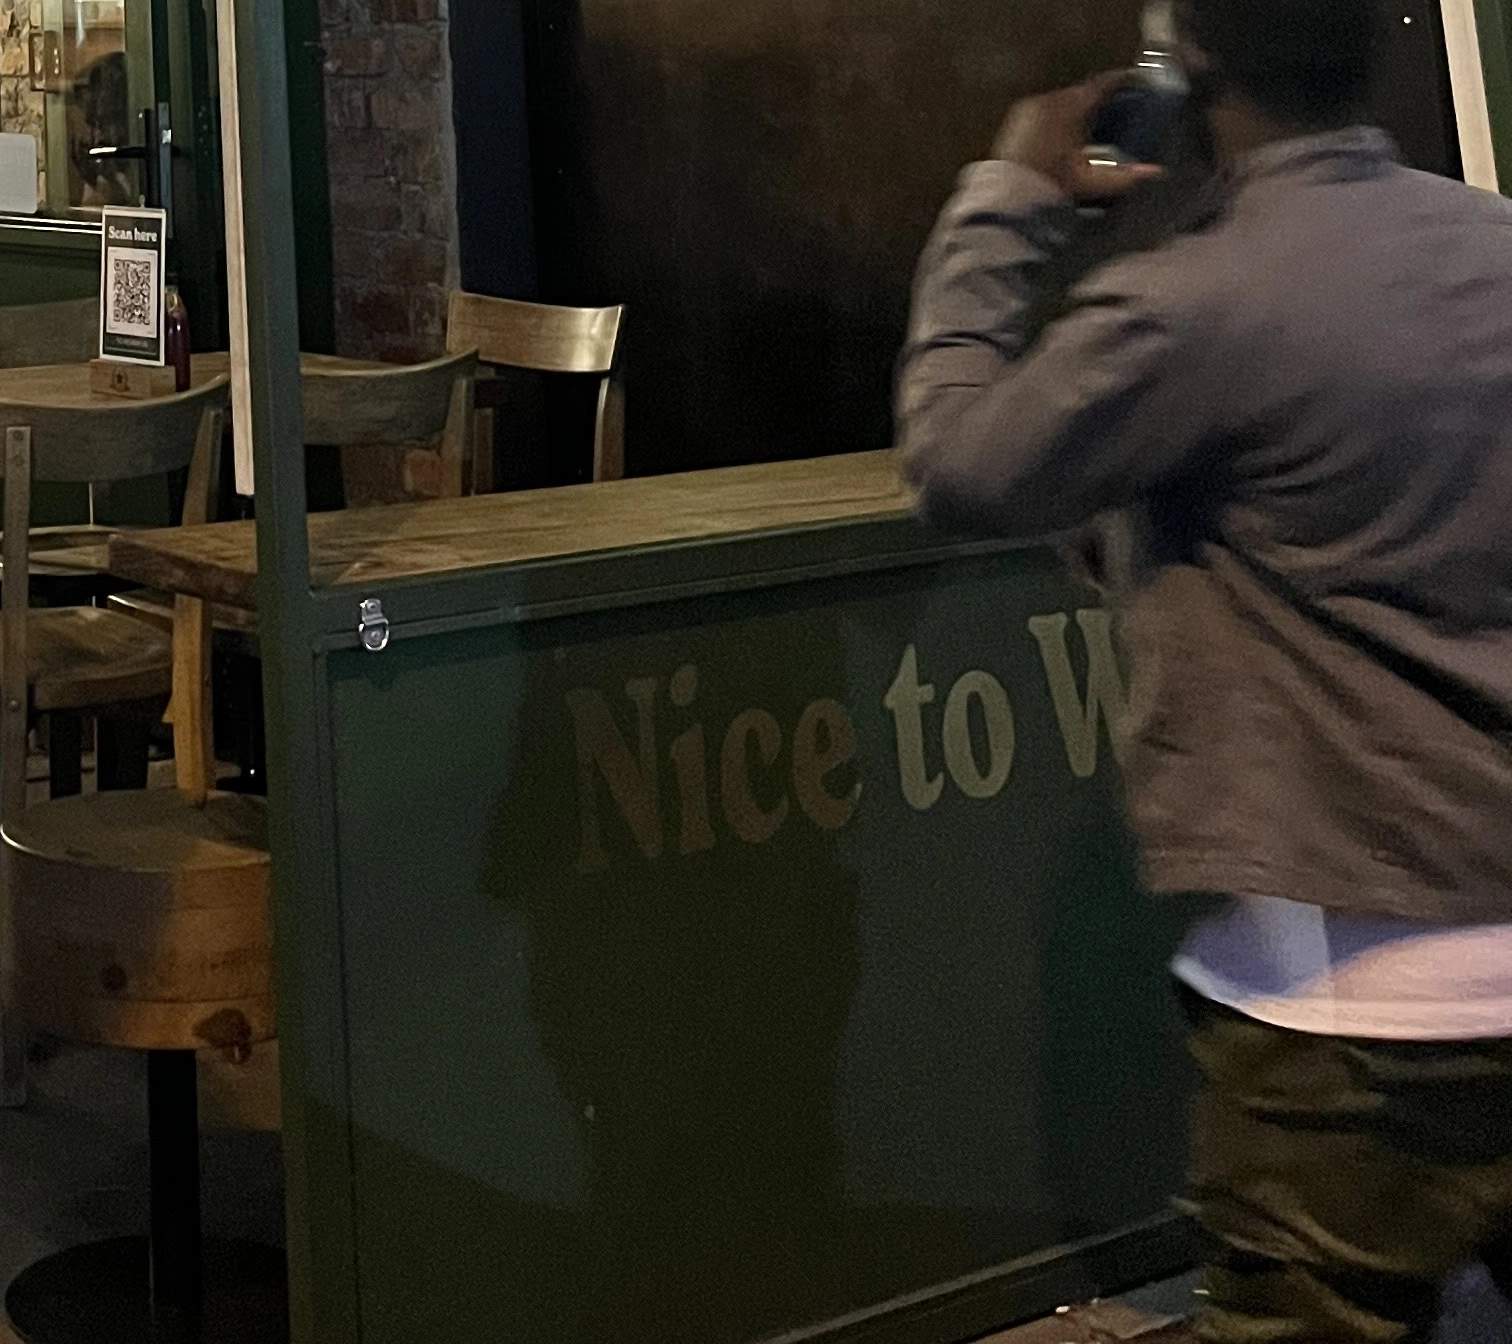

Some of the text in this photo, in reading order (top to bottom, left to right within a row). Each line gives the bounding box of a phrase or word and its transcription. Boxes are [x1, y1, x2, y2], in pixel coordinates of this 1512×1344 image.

[108, 225, 158, 242] Scan here
[563, 664, 863, 876] Nice
[883, 643, 1015, 811] to
